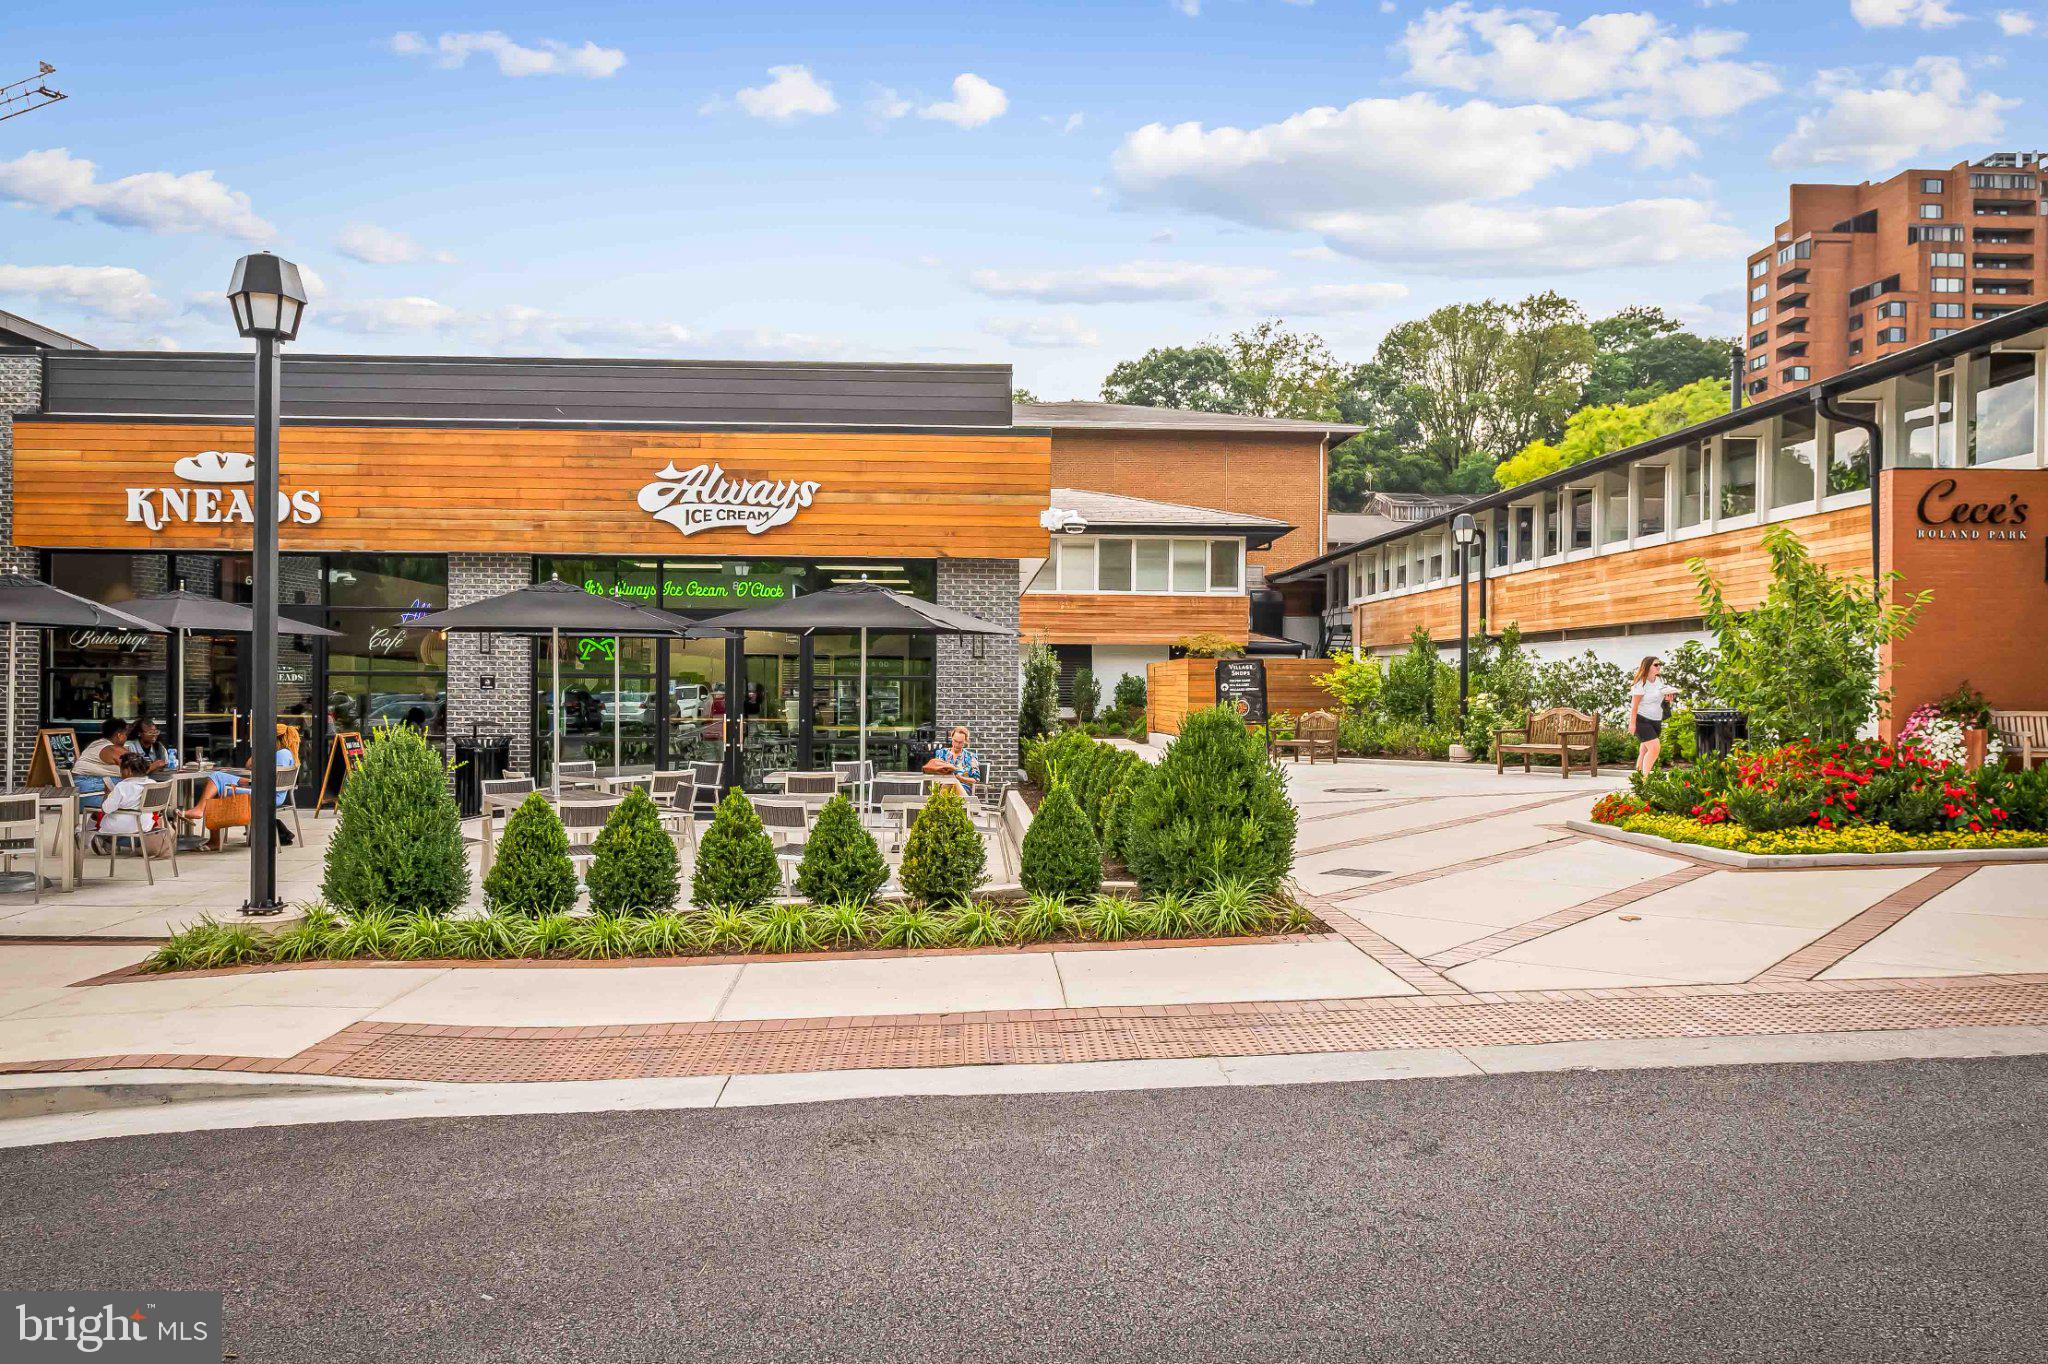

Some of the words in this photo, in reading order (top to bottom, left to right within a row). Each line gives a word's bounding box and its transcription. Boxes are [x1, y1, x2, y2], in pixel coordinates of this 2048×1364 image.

[637, 460, 822, 518] Always
[1917, 479, 2029, 525] Cece's
[685, 509, 712, 526] ICE
[716, 509, 769, 521] CREAM
[1917, 529, 1980, 540] ROLAND
[1988, 530, 2027, 540] PARK
[584, 580, 604, 596] It's
[662, 580, 684, 597] Ice
[686, 581, 728, 598] Cream
[736, 581, 785, 598] O'Clock
[69, 630, 150, 653] Bakeshop
